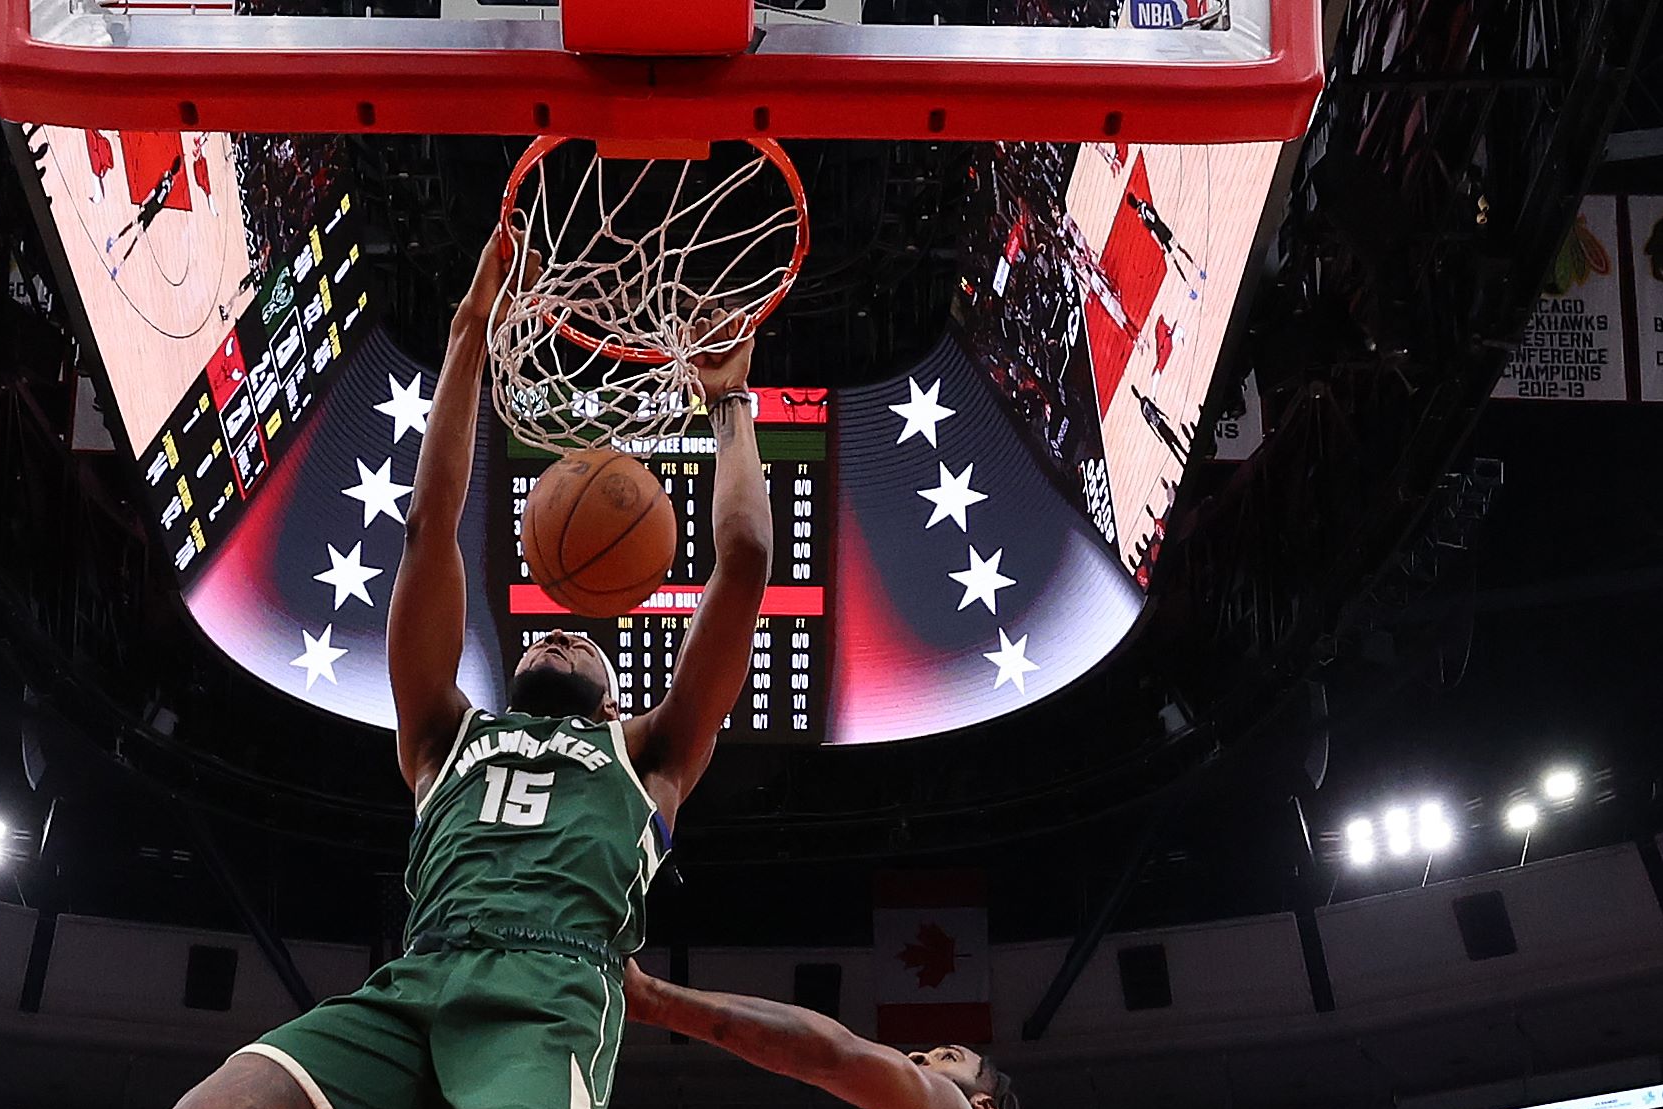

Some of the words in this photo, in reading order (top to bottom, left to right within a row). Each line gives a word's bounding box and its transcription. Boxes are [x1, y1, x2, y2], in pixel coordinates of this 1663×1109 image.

[1138, 3, 1173, 26] NBA
[1539, 299, 1584, 314] CAGO
[1523, 332, 1594, 347] ESTERN
[1507, 349, 1608, 364] ONFERENCE
[1518, 381, 1585, 397] 2012-13
[662, 463, 676, 474] PTS
[684, 463, 698, 475] REB
[799, 464, 807, 474] FT
[795, 479, 811, 496] 0/0
[794, 500, 811, 517] 0/0
[794, 521, 811, 537] 0/0
[794, 542, 810, 558] 0/0
[793, 563, 810, 579] 0/0
[662, 617, 676, 629] PTS
[796, 618, 805, 628] FT
[665, 632, 672, 647] 2
[753, 632, 771, 648] 0/0
[792, 633, 809, 649] 0/0
[754, 653, 770, 668] 0/0
[792, 653, 808, 669] 0/0
[754, 673, 770, 689] 0/0
[792, 674, 808, 689] 0/0
[754, 693, 767, 709] 0/1
[793, 694, 806, 709] 1/1
[753, 714, 767, 729] 0/1
[793, 714, 807, 729] 1/2
[479, 765, 555, 826] 15
